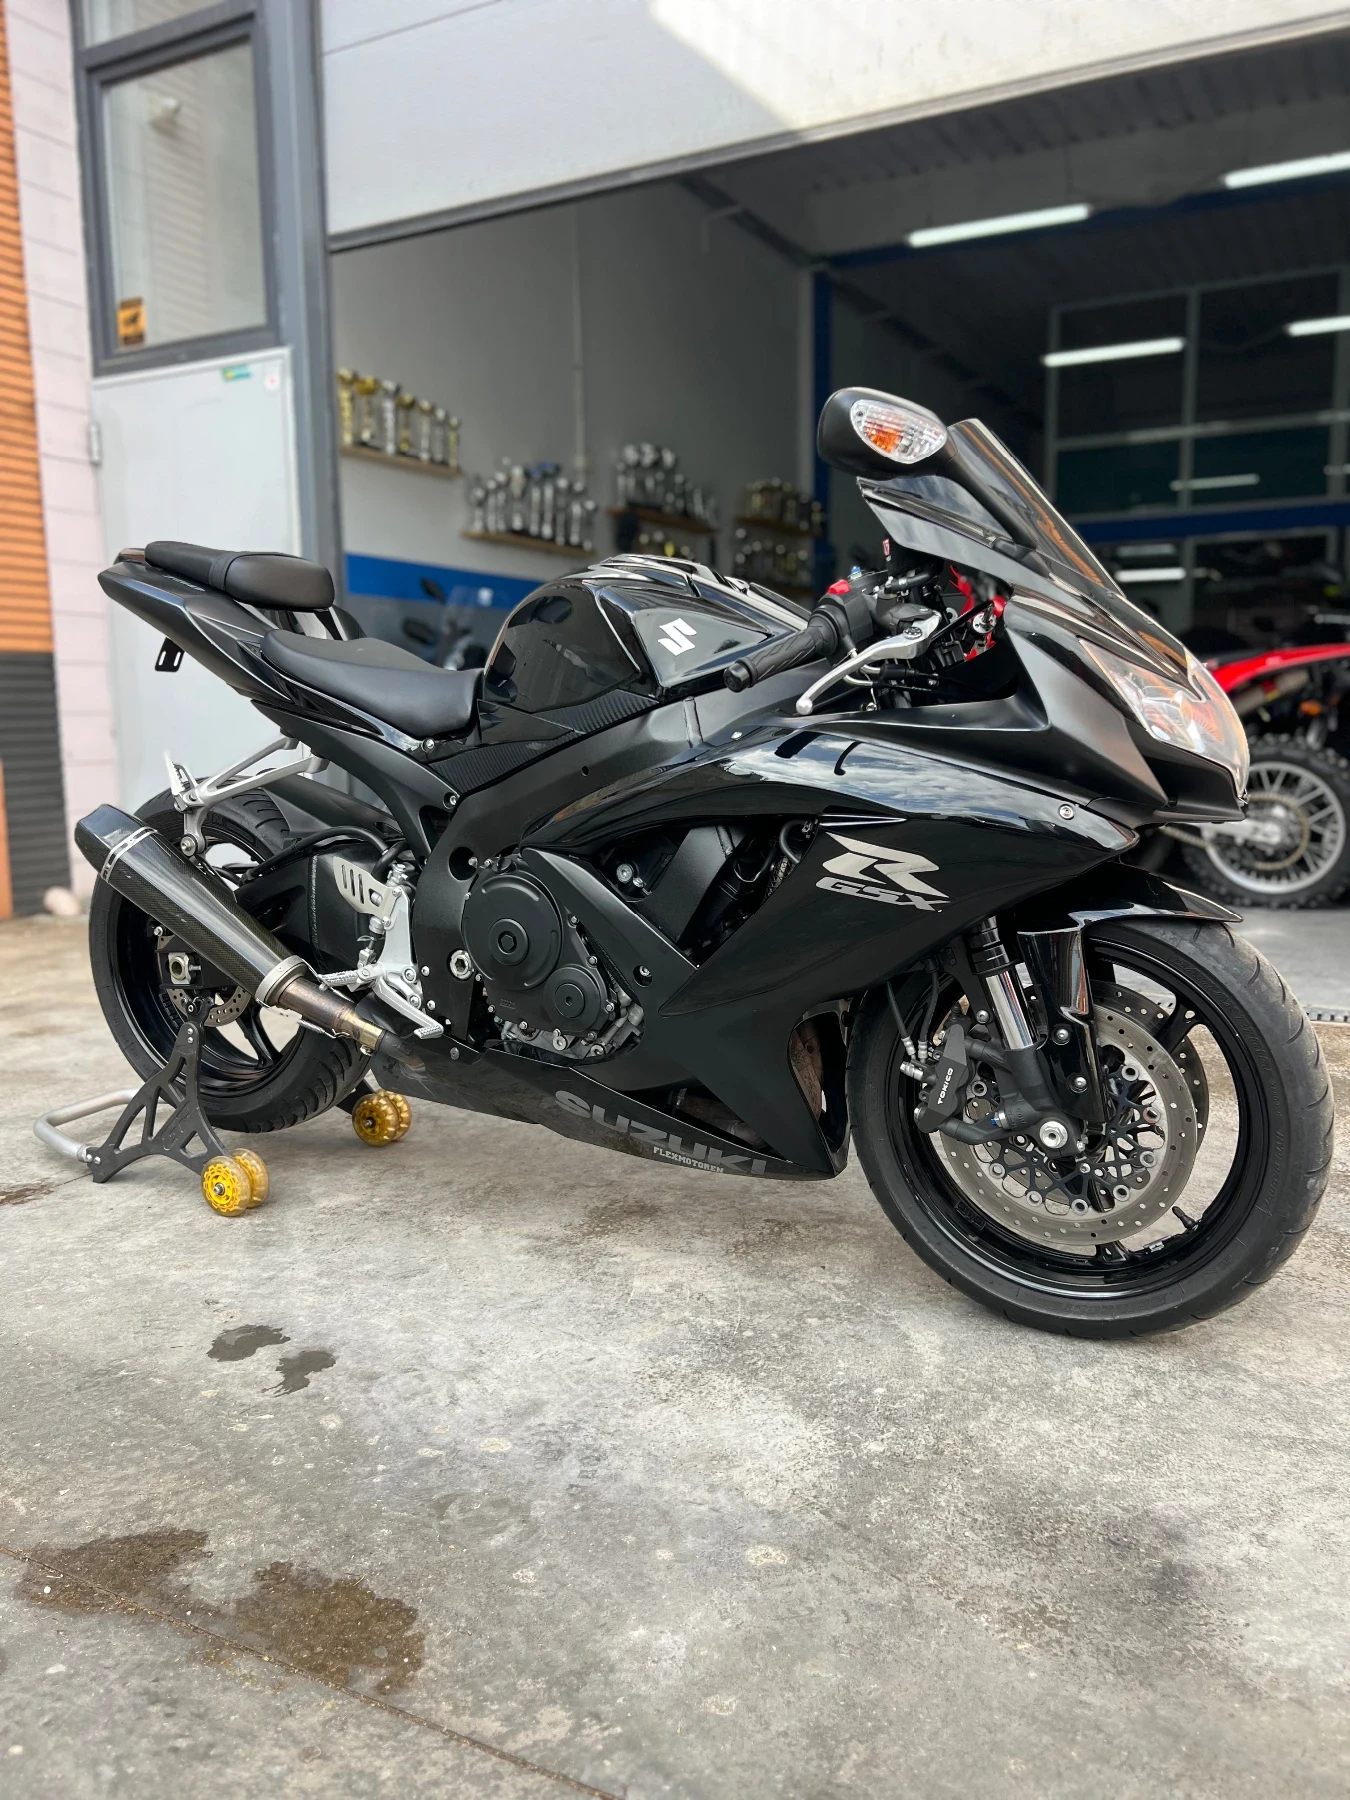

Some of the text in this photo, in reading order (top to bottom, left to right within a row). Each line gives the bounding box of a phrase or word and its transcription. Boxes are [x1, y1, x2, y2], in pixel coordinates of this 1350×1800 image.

[937, 1067, 954, 1105] TOKICO
[554, 1090, 767, 1175] SUZUKI
[653, 1146, 724, 1174] FLEXMOTOREN
